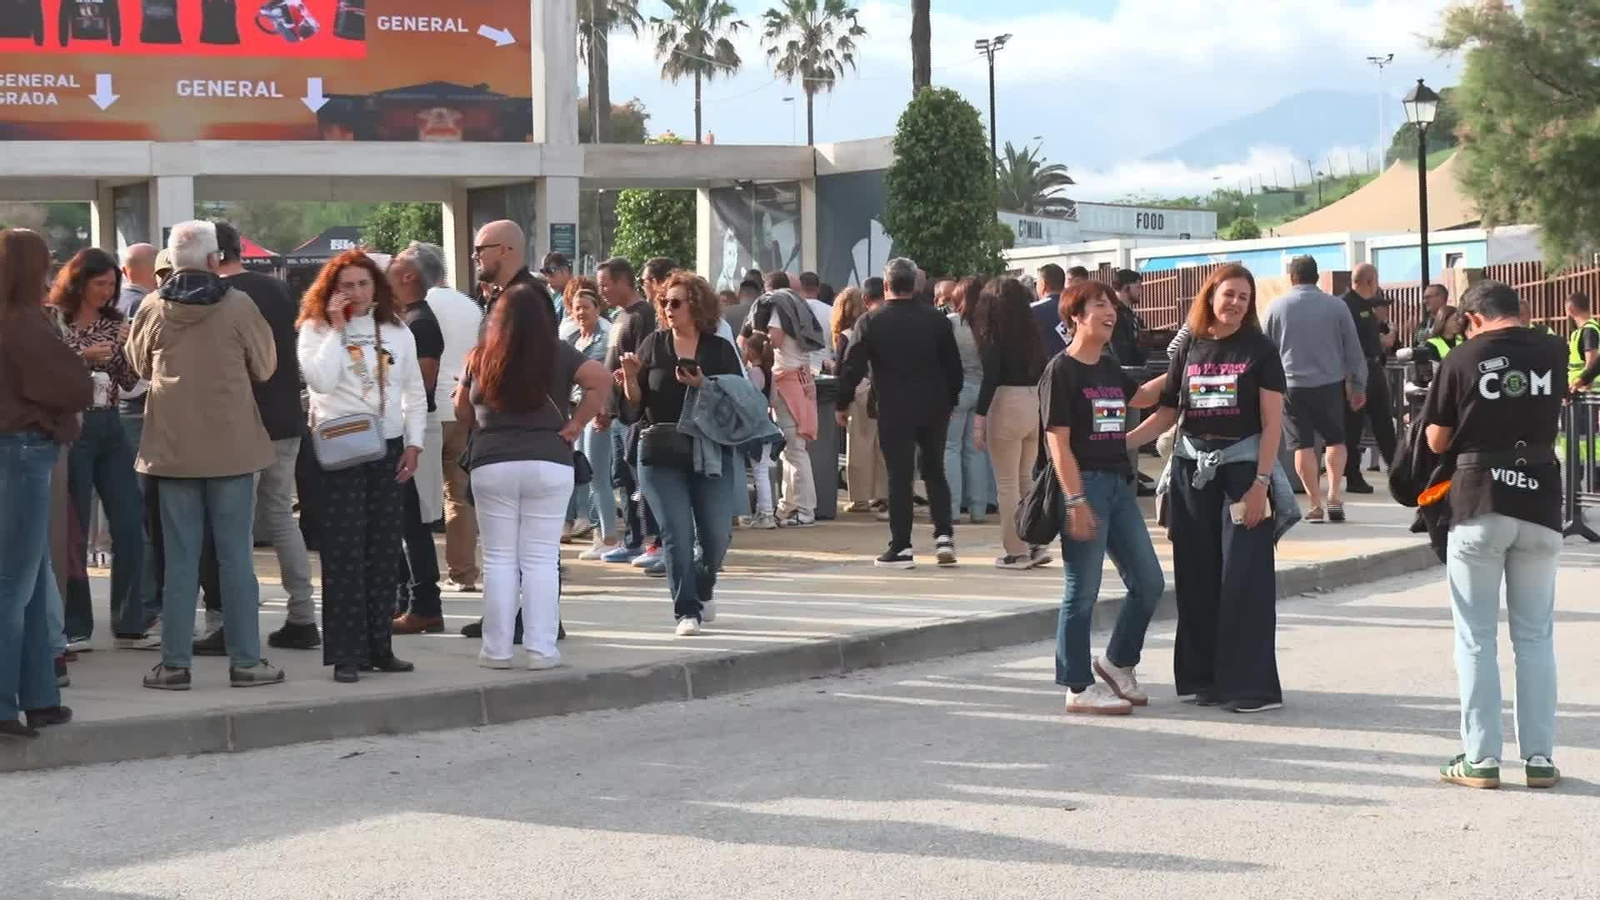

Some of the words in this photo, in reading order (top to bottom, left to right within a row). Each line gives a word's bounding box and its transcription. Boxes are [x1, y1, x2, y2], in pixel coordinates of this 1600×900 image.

[377, 16, 469, 32] GENERAL
[177, 80, 284, 97] GENERAL
[1136, 212, 1164, 230] FOOD
[1490, 468, 1539, 490] VIDEO
